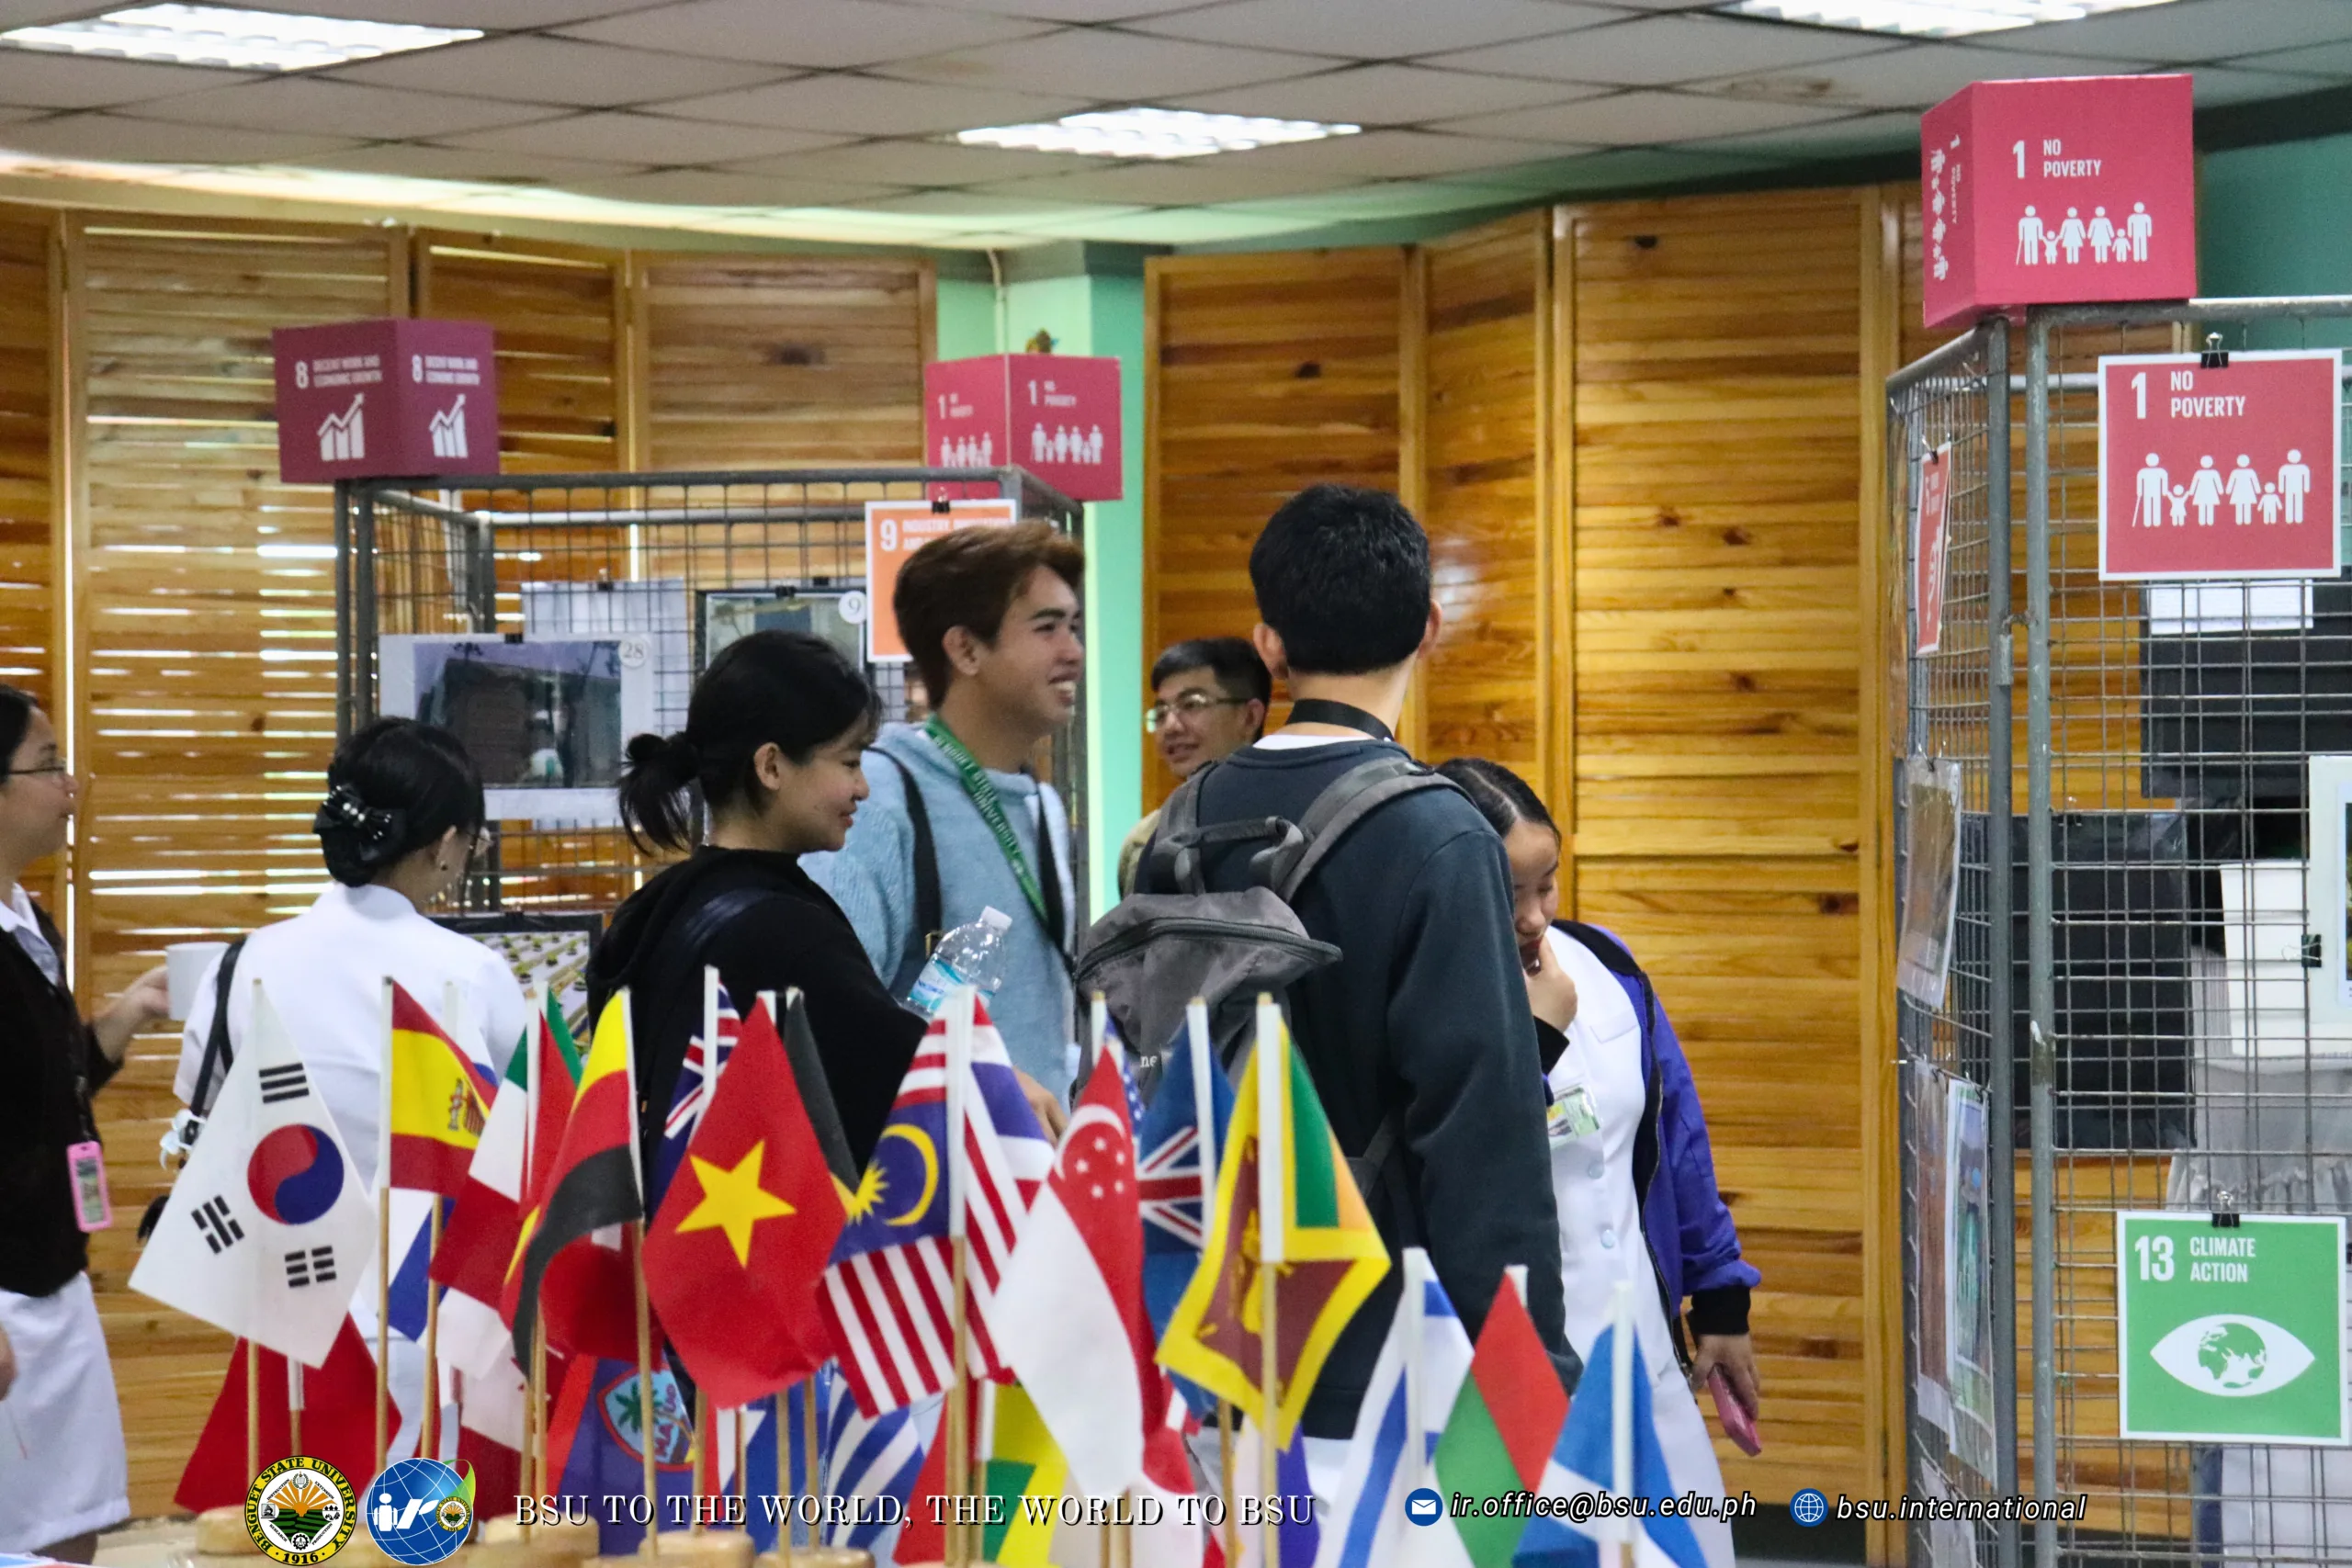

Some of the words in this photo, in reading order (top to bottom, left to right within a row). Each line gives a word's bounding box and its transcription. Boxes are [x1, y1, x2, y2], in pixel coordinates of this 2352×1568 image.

[2012, 140, 2025, 179] 1
[2042, 139, 2062, 156] NO
[2042, 159, 2102, 178] POVERTY
[295, 360, 309, 389] 8
[412, 354, 423, 383] 8
[2170, 370, 2194, 391] NO
[1026, 379, 1037, 405] 1
[2131, 371, 2146, 420] 1
[937, 394, 946, 420] 1
[2170, 396, 2246, 419] POVERTY
[879, 518, 898, 552] 9
[848, 596, 862, 615] 9
[2134, 1235, 2176, 1282] 13
[2189, 1236, 2256, 1258] CLIMATE
[2189, 1261, 2248, 1282] ACTION
